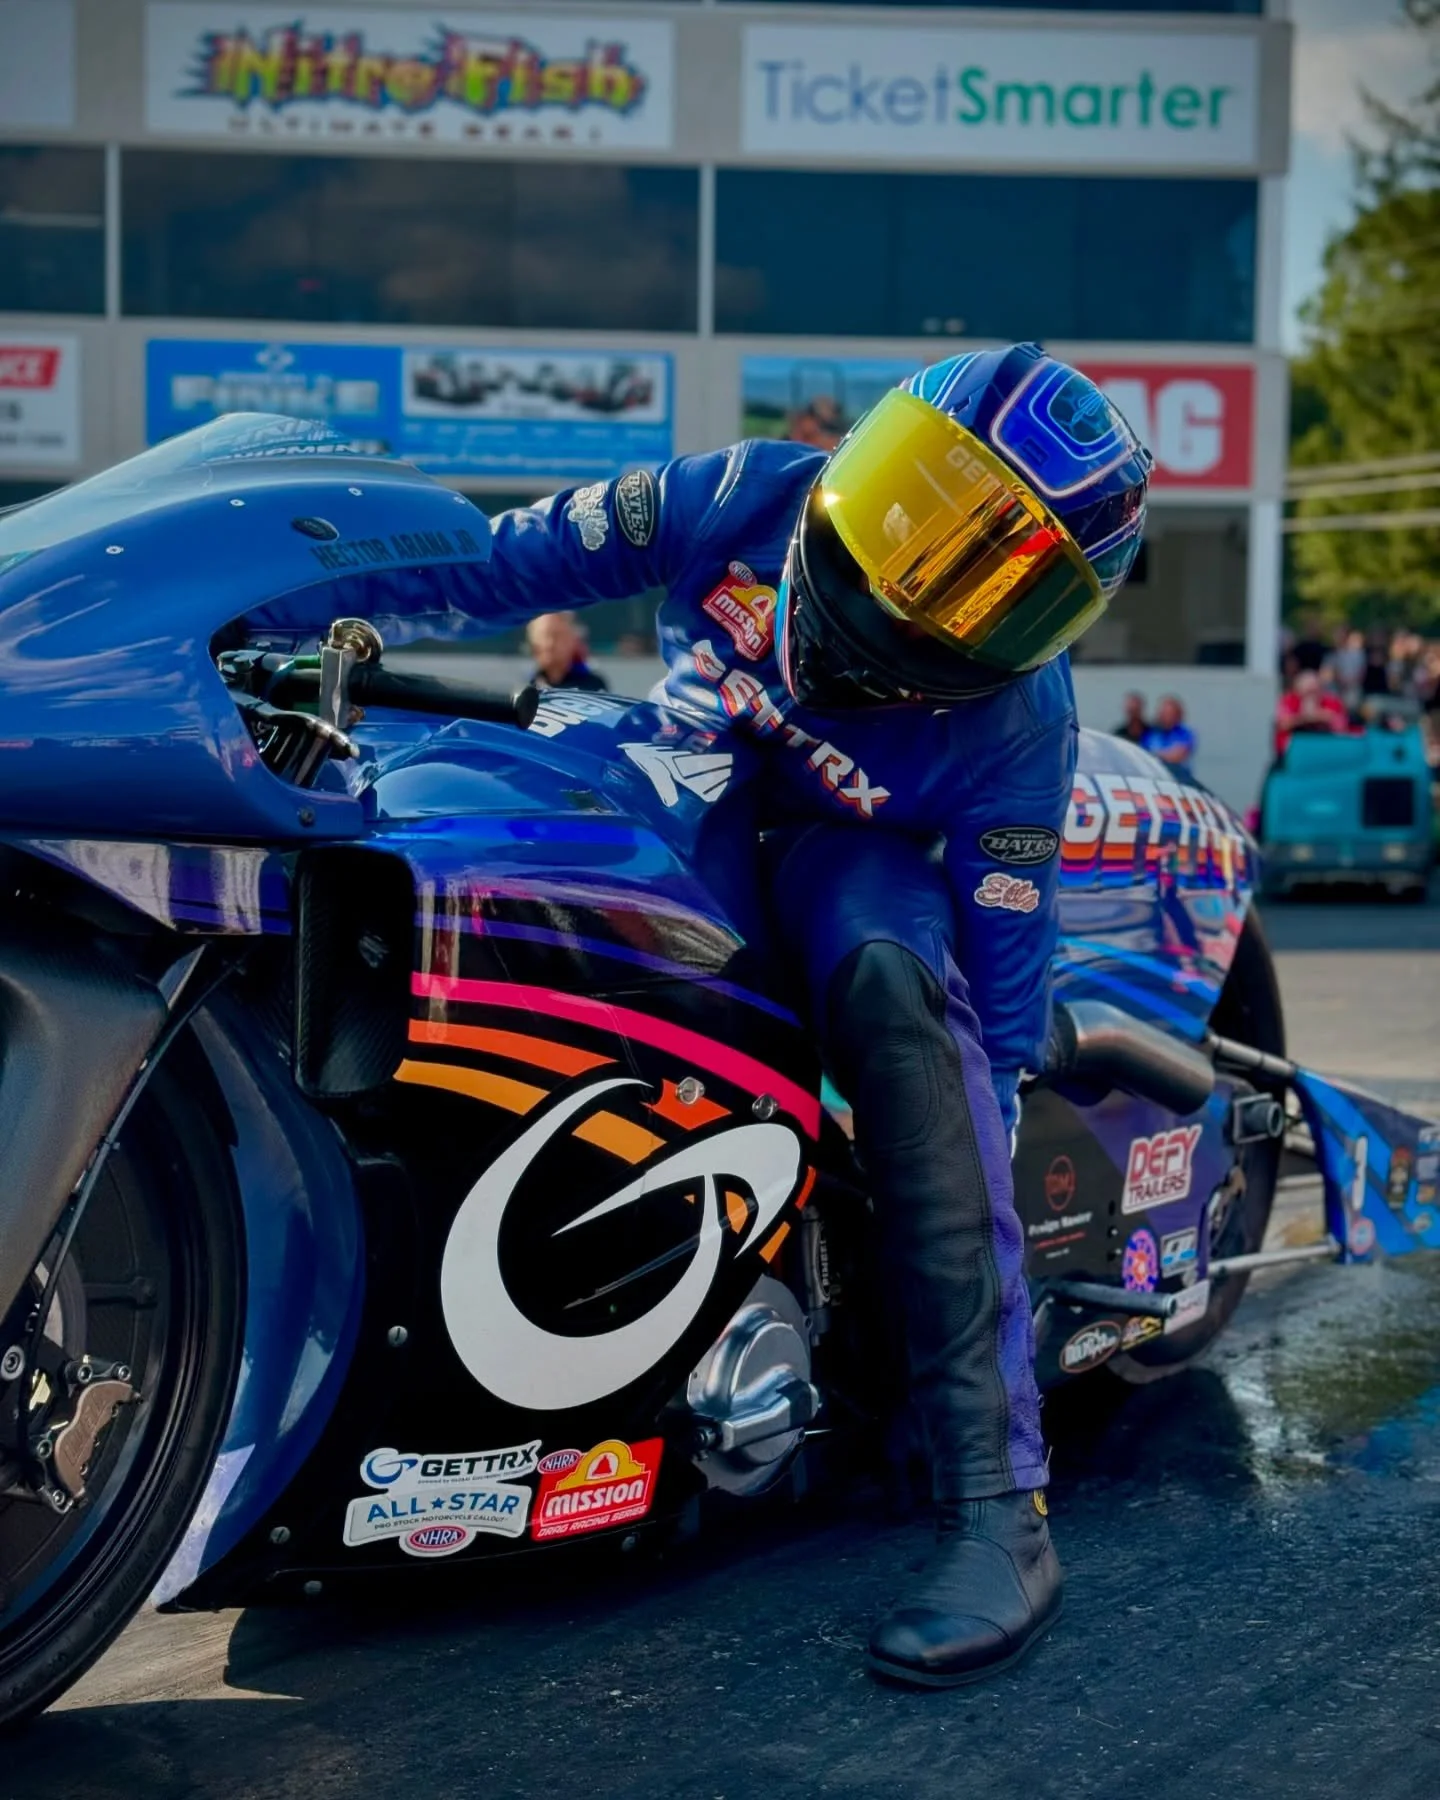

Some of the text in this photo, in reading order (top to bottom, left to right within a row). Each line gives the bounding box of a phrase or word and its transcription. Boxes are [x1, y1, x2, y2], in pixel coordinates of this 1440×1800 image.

[758, 60, 1233, 130] TicketSmarter
[628, 471, 648, 546] BATES
[309, 539, 394, 571] HECTOR
[390, 530, 456, 561] ARANA
[692, 640, 891, 817] GETTRX
[982, 836, 1058, 853] BATES
[1130, 1127, 1201, 1180] DEFY
[1128, 1175, 1187, 1204] TRAILERS
[420, 1446, 537, 1478] GETTRX
[545, 1454, 577, 1470] NHRA
[366, 1492, 520, 1524] ALL STAR
[544, 1479, 644, 1519] MISSION
[374, 1513, 506, 1530] PRO STOCK MOTORCYCLE CALLOUT
[418, 1526, 460, 1546] NHRA
[536, 1504, 648, 1537] DRAG RACING SERIES
